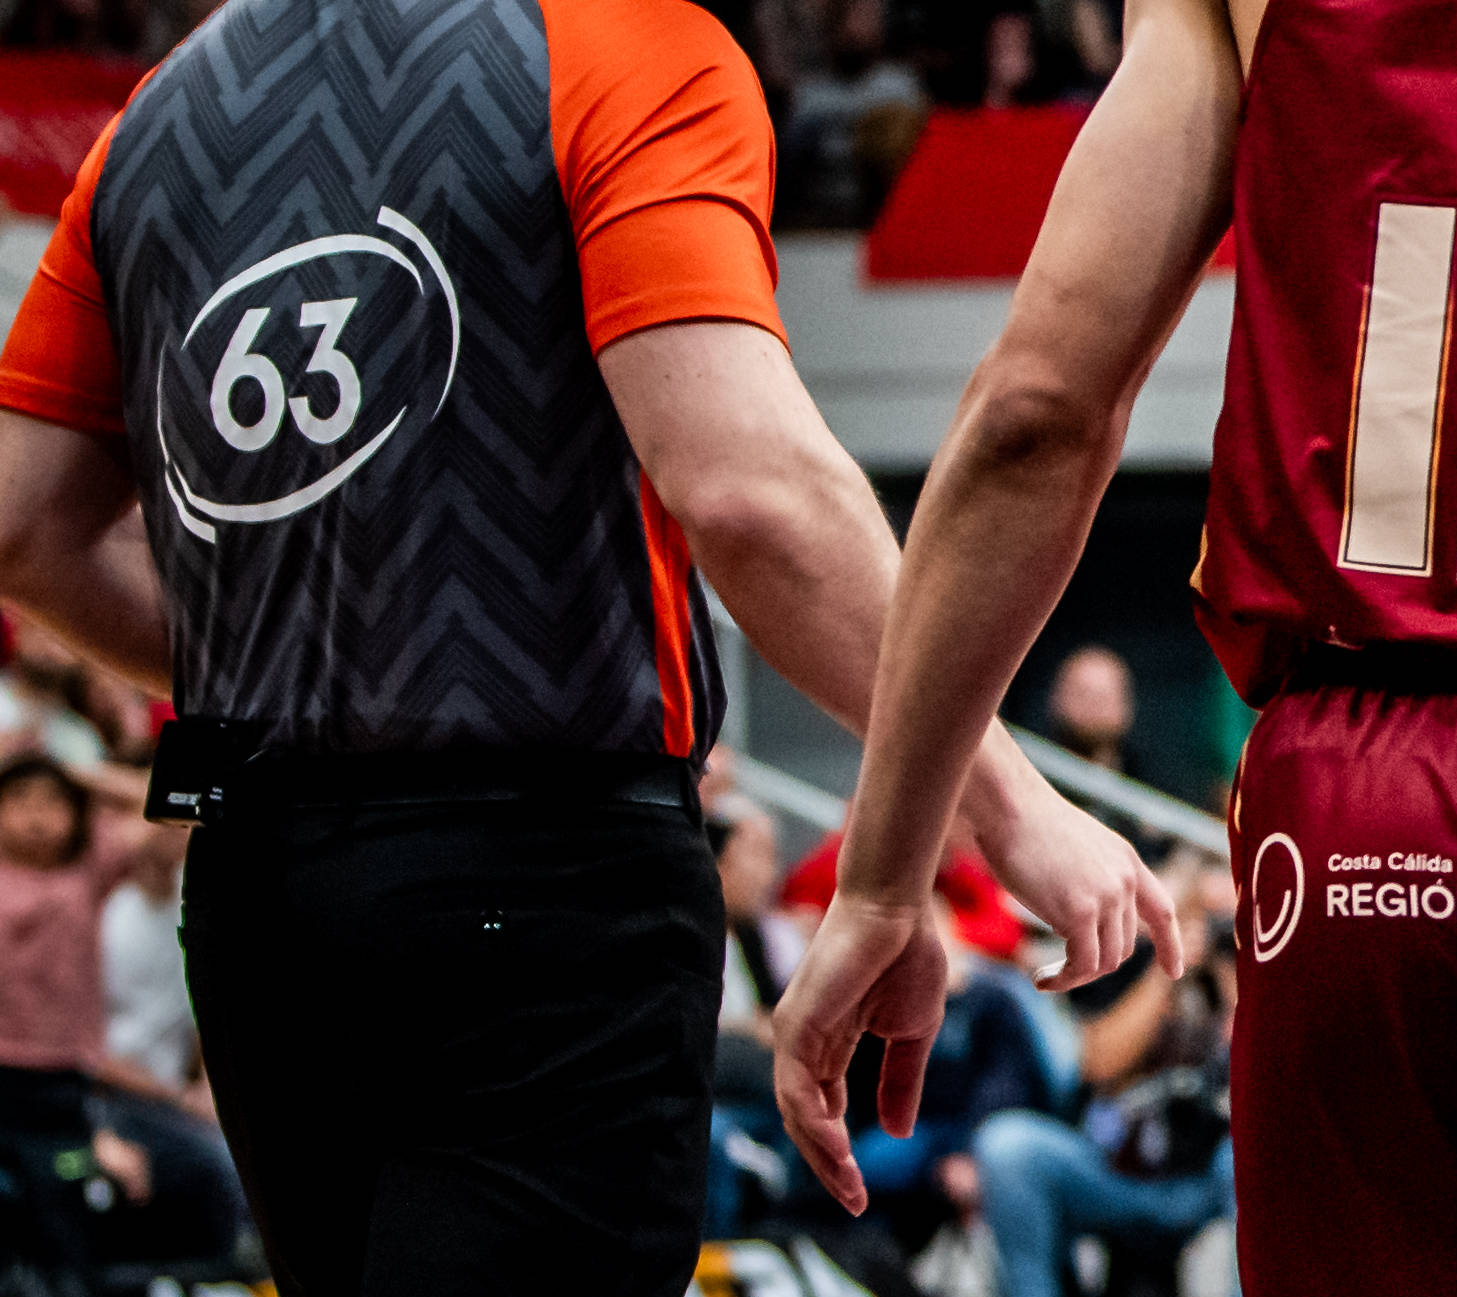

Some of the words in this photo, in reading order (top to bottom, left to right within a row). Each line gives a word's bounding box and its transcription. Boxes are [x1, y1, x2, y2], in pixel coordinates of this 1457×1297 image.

[210, 297, 361, 452] 63
[1328, 853, 1382, 872] Costa
[1387, 852, 1453, 873] Cálida
